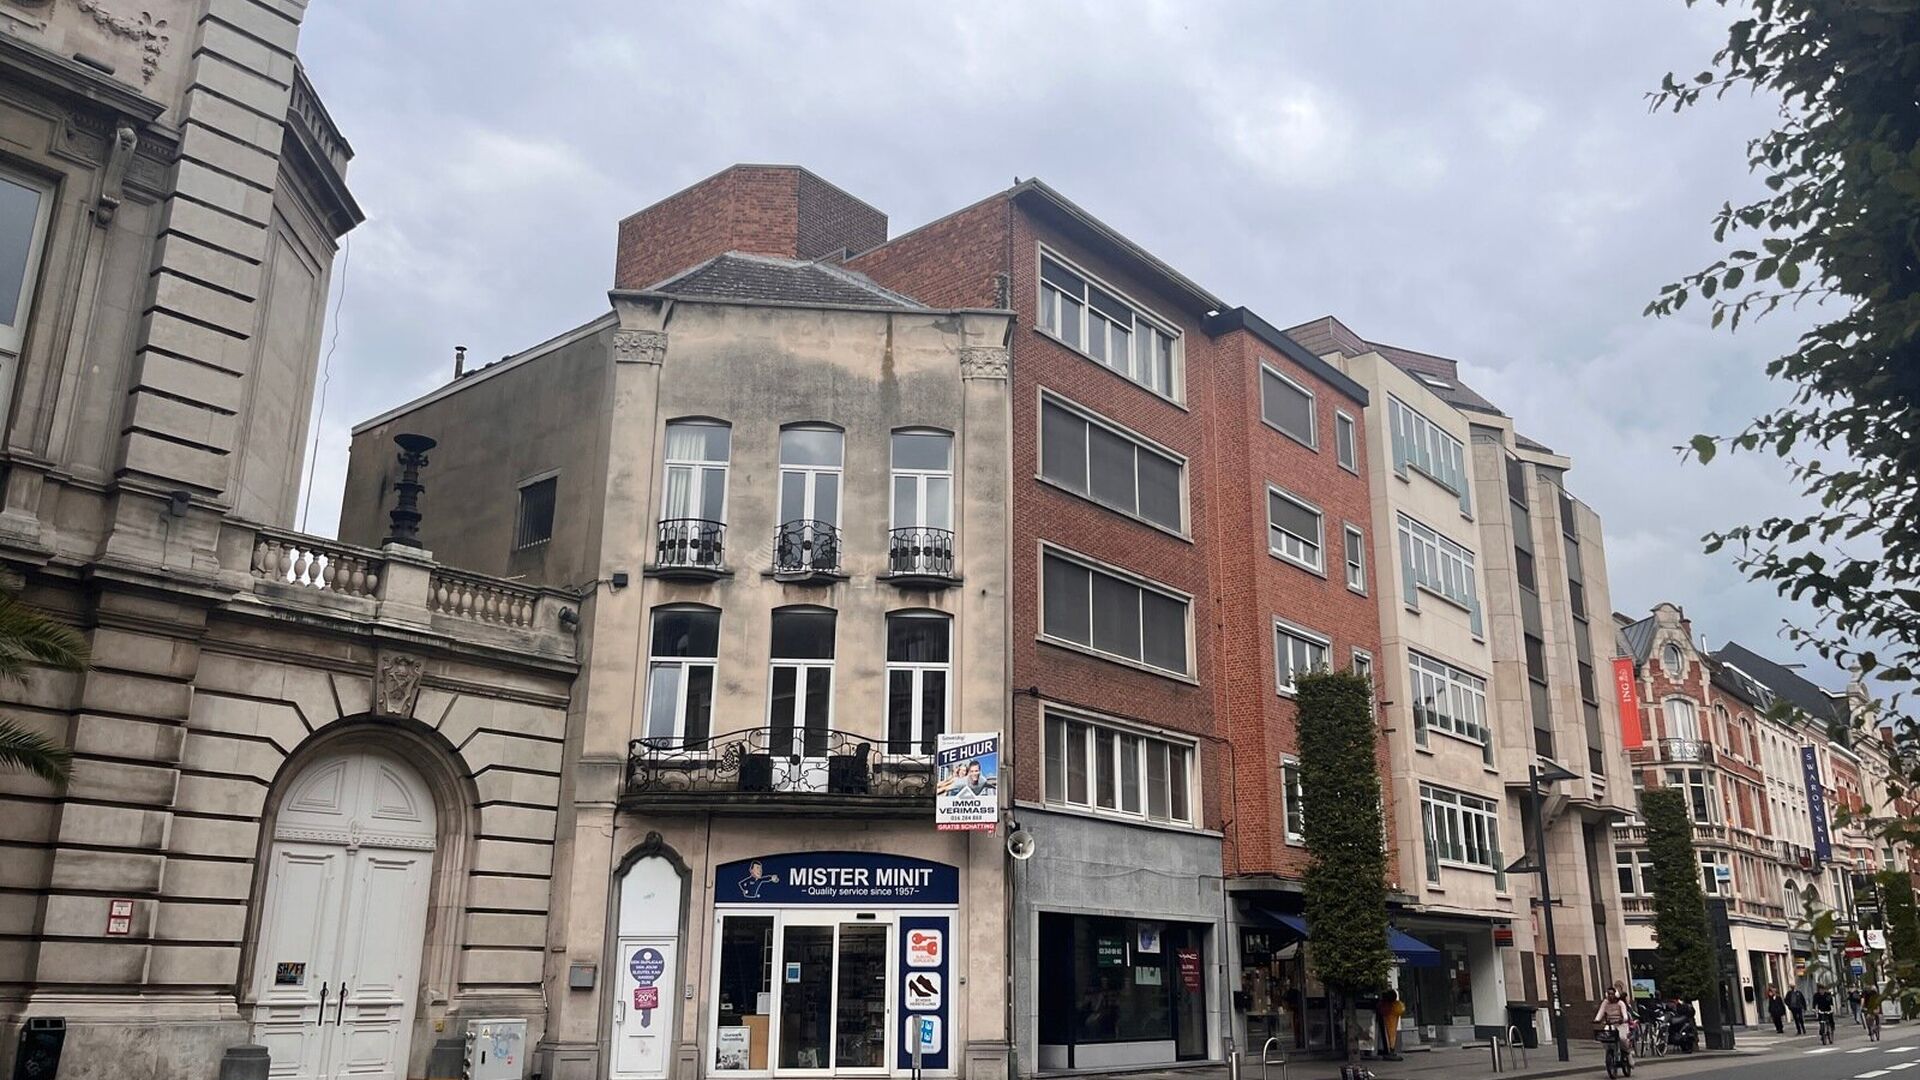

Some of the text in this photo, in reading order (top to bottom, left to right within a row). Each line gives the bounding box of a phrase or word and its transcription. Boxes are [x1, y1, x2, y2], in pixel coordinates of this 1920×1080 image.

[1621, 682, 1632, 703] ING
[942, 740, 993, 764] TE HUUR
[1806, 753, 1824, 843] SWAROVSKI
[939, 807, 995, 815] VERIMASS
[789, 867, 933, 886] MISTER MINIT
[839, 887, 868, 896] service
[870, 887, 892, 896] since
